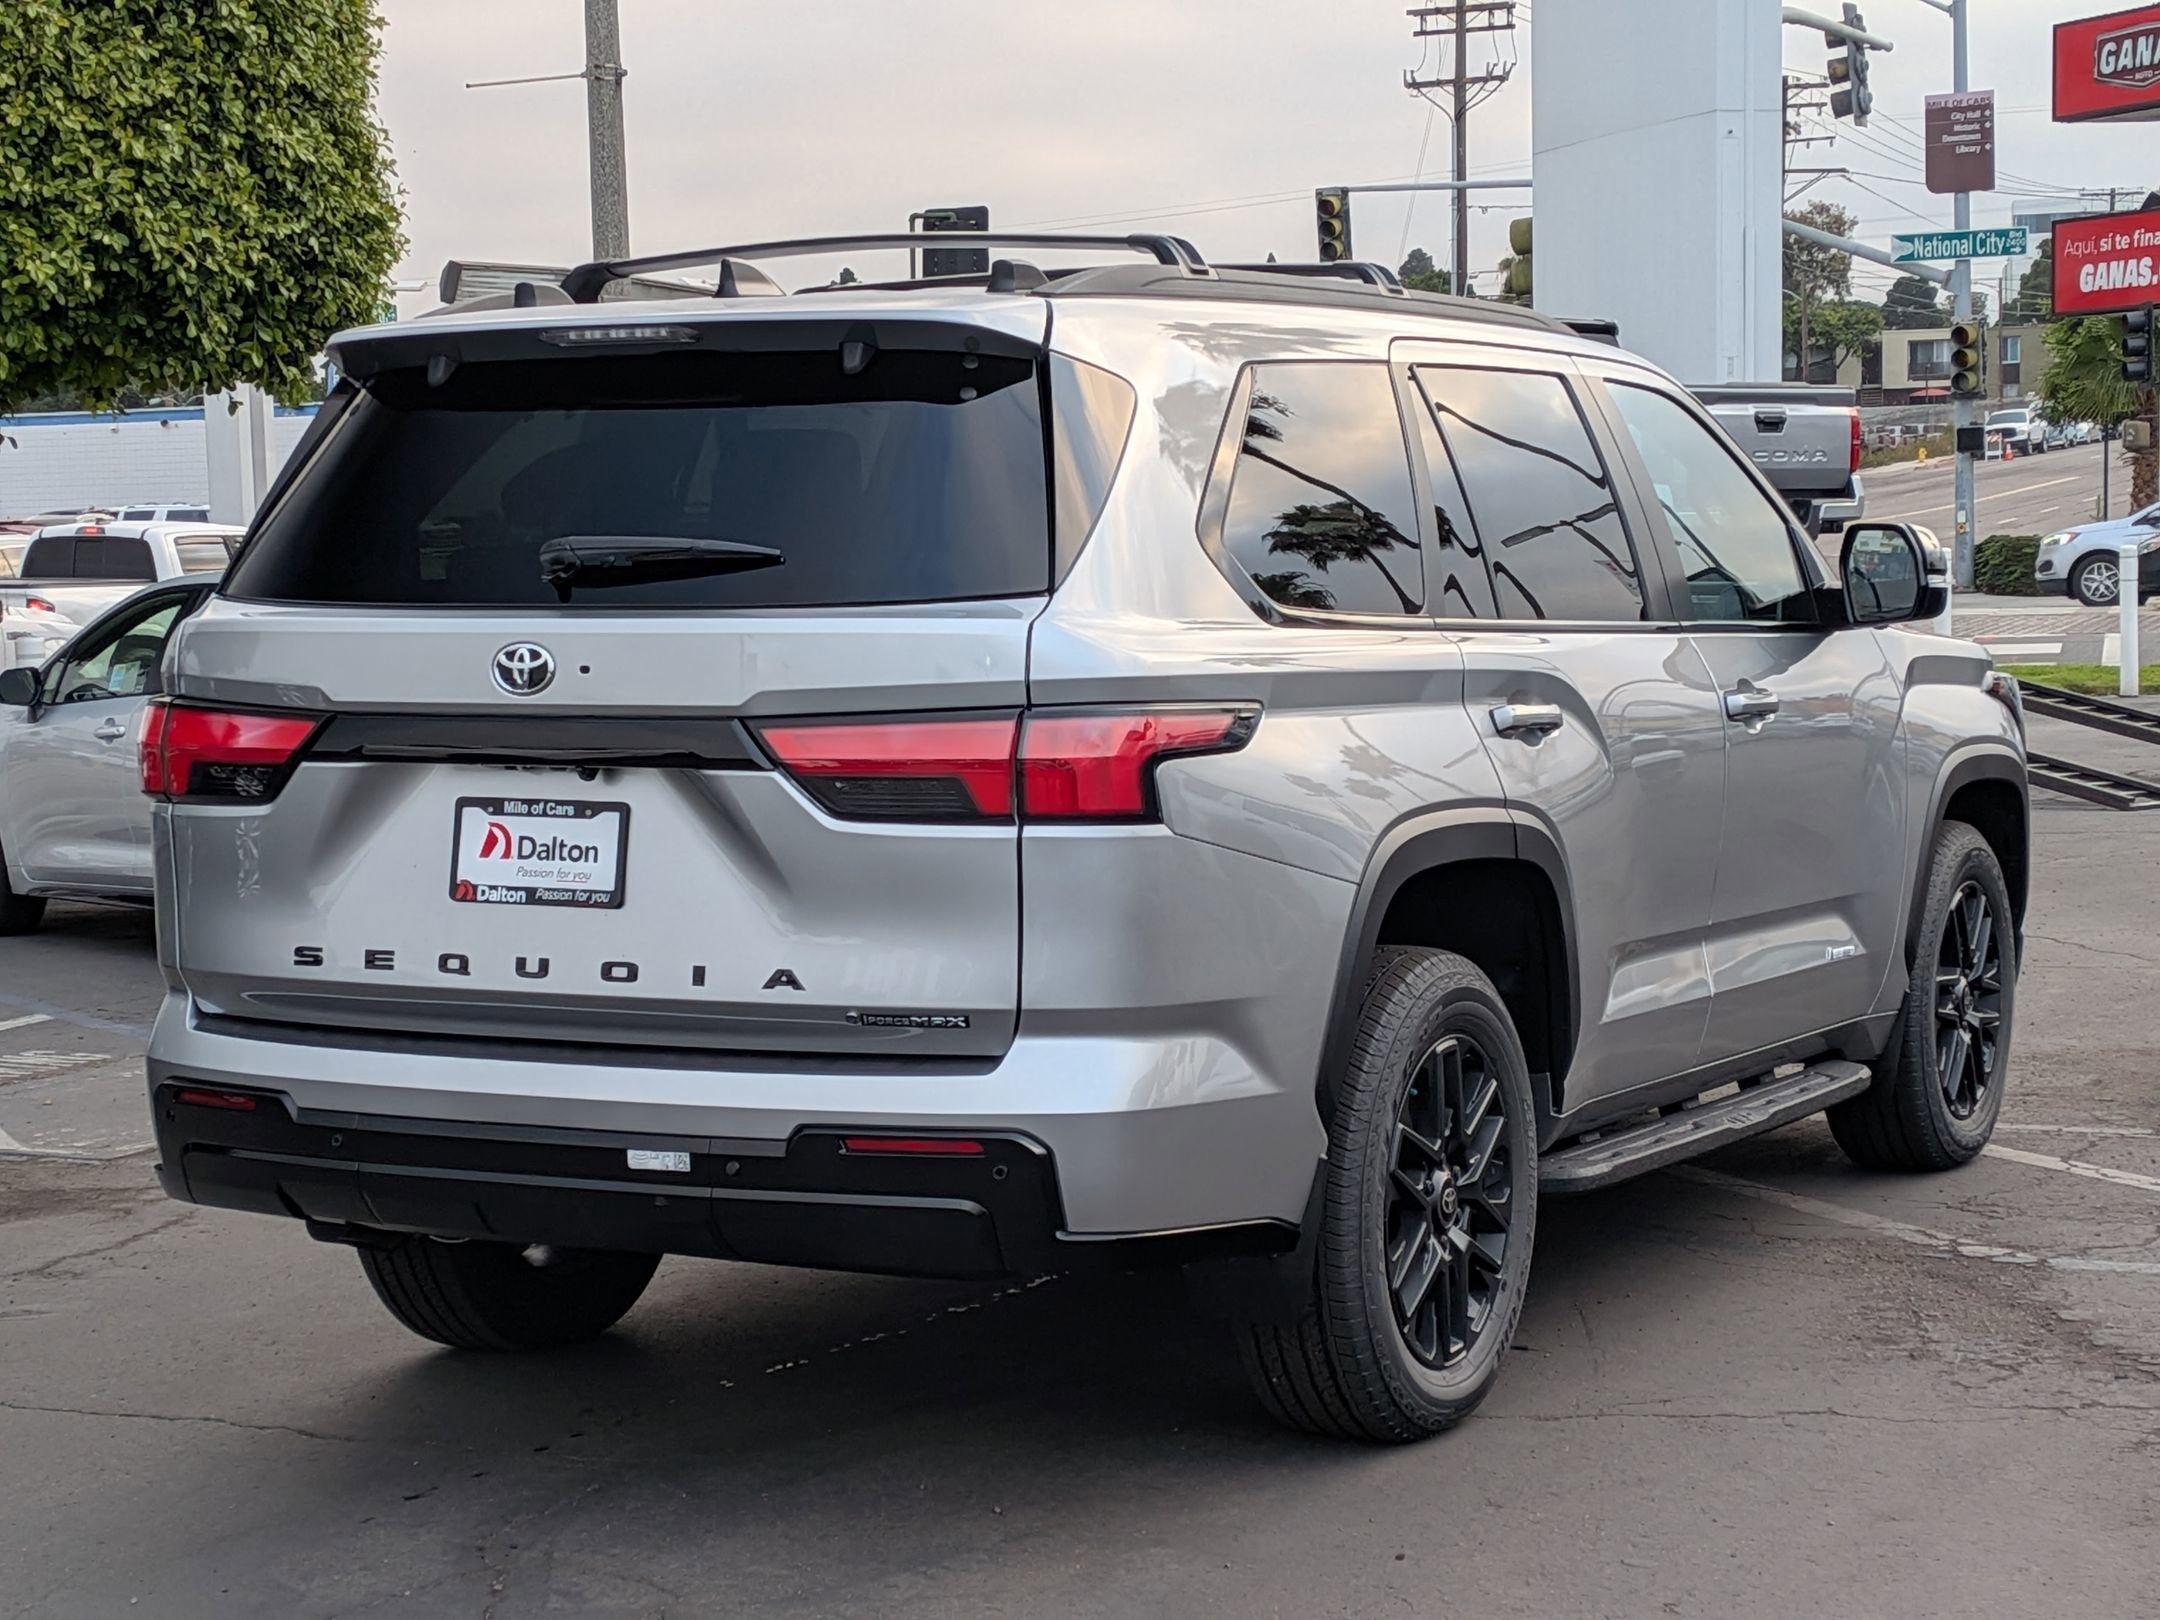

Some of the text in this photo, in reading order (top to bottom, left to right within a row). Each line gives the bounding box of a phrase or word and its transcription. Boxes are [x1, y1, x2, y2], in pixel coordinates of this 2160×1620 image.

[1952, 98, 1965, 107] OF
[1966, 96, 1992, 106] CARS
[1950, 110, 1981, 121] City Hall
[1953, 122, 1981, 132] Historic
[1941, 133, 1981, 143] Downtown
[1955, 145, 1981, 154] Library
[2008, 230, 2023, 239] Blvd
[1913, 232, 2005, 259] National City
[2064, 235, 2098, 258] Aquí,
[2099, 232, 2114, 252] sí
[2115, 233, 2130, 250] te
[2080, 256, 2160, 293] GANAS.
[503, 801, 575, 816] Mile of Cars
[516, 835, 599, 863] Dalton
[515, 866, 592, 883] Passion for you
[476, 885, 611, 904] Dalton Passion for you
[293, 945, 807, 992] SEQUOIA
